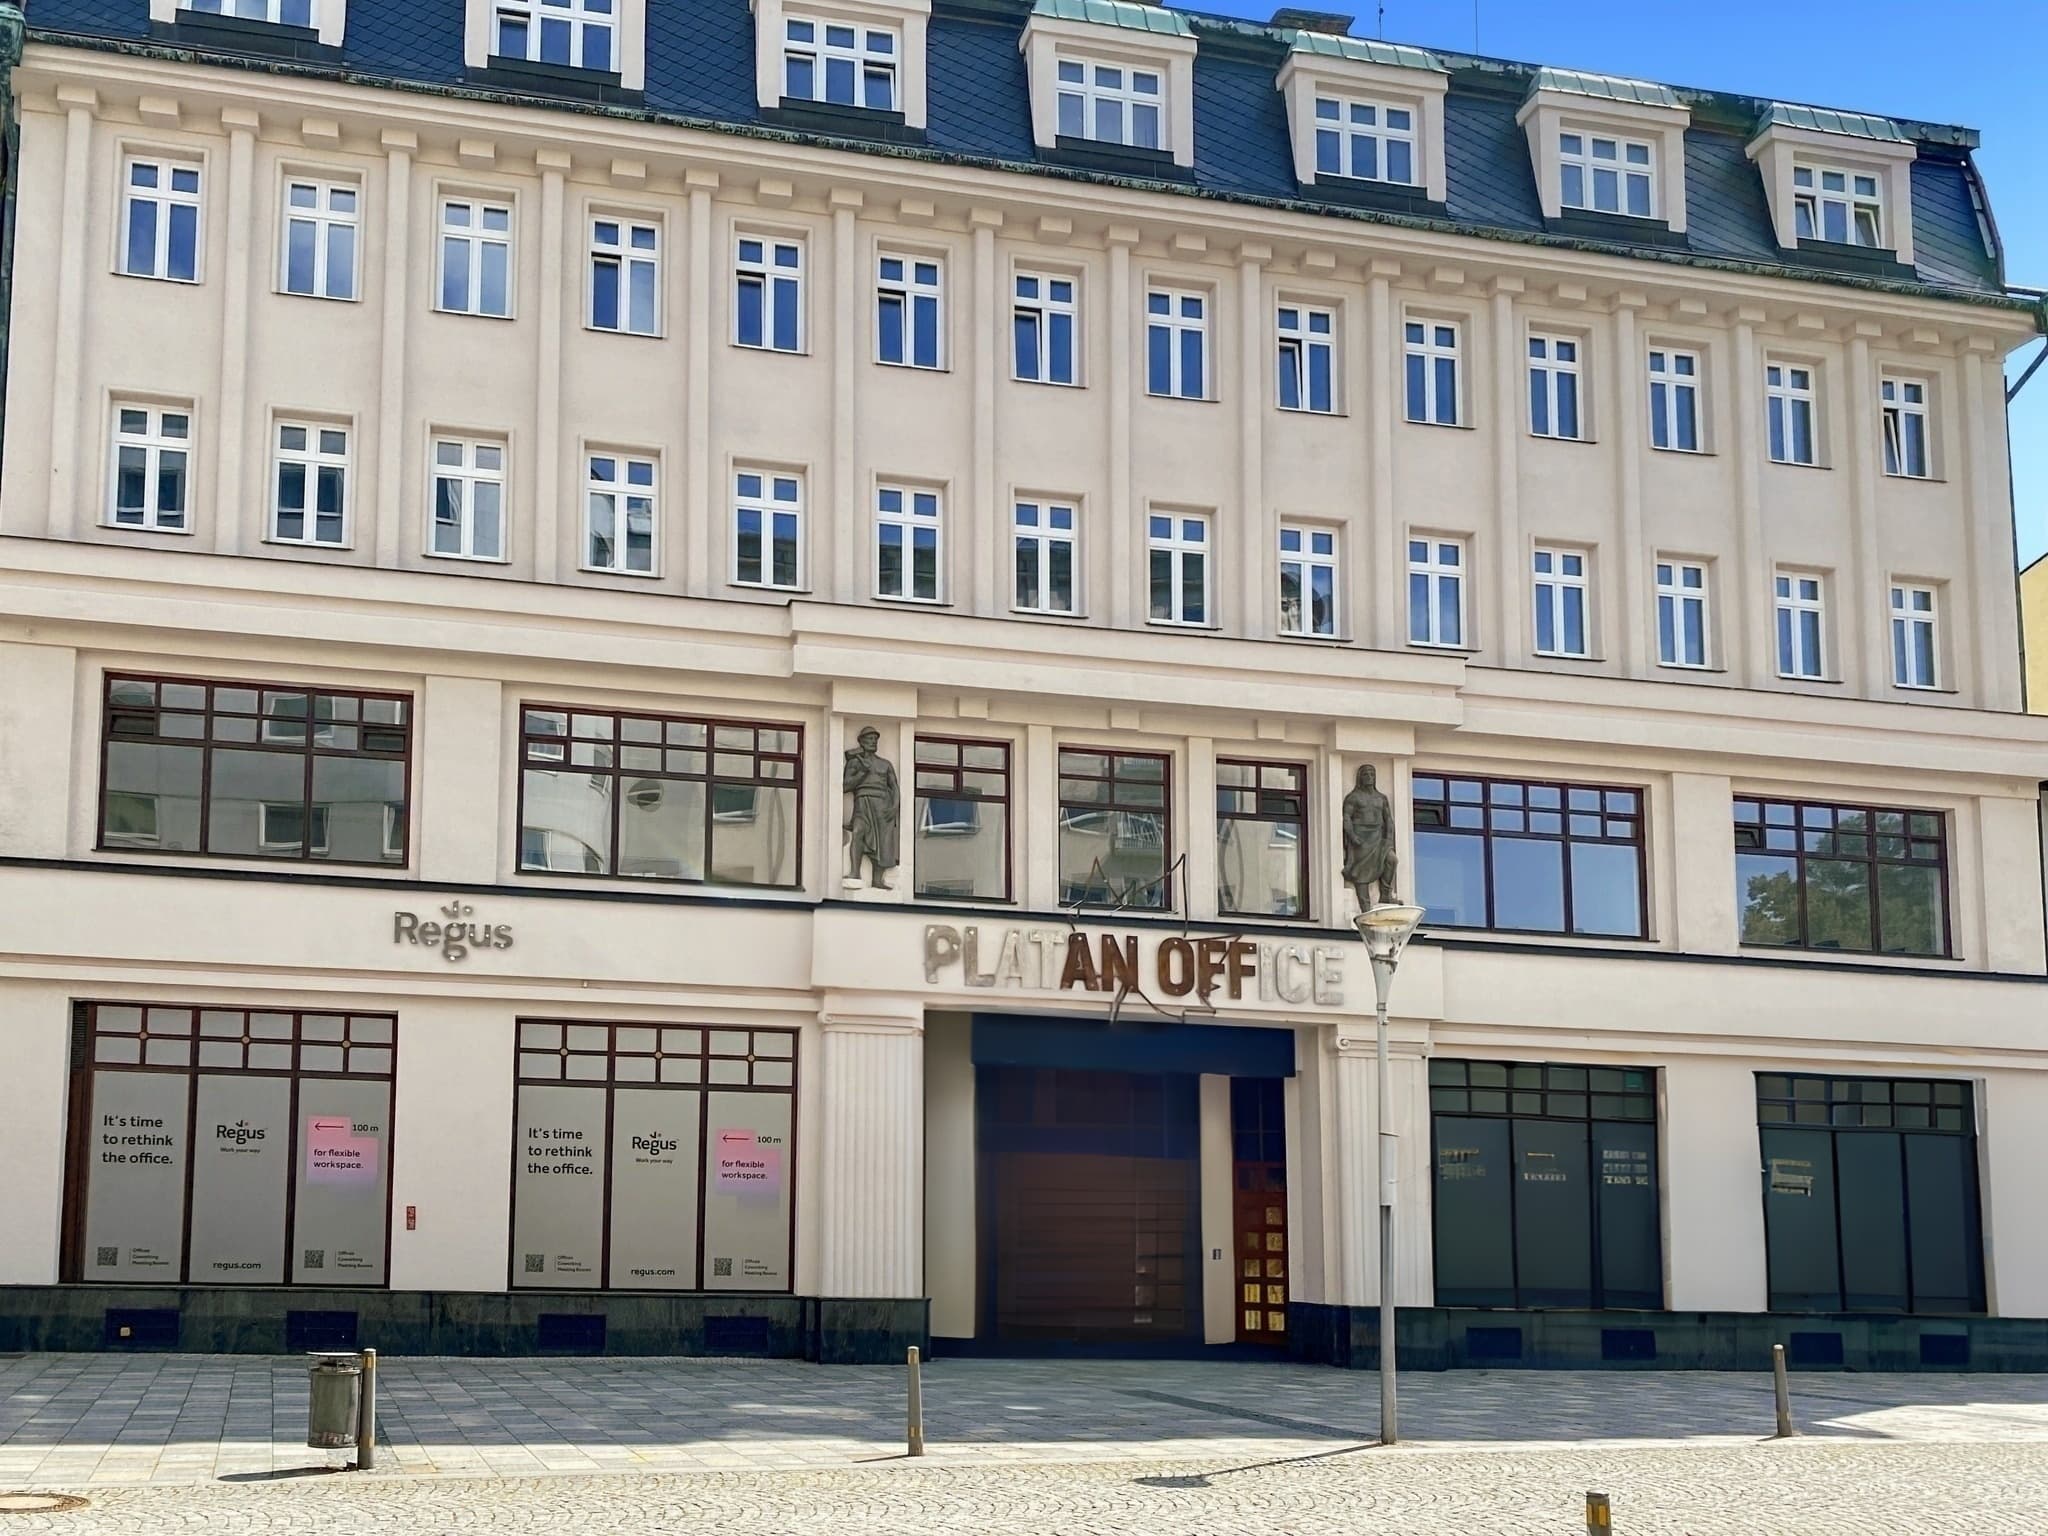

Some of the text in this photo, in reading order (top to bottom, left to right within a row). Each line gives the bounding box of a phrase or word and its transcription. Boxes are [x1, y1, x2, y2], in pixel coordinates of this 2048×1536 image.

[394, 912, 514, 961] Regus
[924, 924, 1345, 1006] PLATAN OFFICE
[103, 1114, 163, 1129] It's time
[352, 1124, 368, 1132] 100
[528, 1127, 583, 1140] It's time
[103, 1133, 173, 1147] to rethink
[216, 1125, 266, 1145] Regus
[757, 1136, 772, 1144] 100
[528, 1145, 592, 1158] to rethink
[632, 1136, 677, 1155] Regus
[102, 1151, 174, 1165] the office.
[313, 1148, 361, 1158] for flexible
[313, 1160, 364, 1171] workspace.
[527, 1163, 593, 1175] the office.
[722, 1160, 765, 1169] for flexible
[721, 1171, 768, 1181] workspace.
[212, 1260, 262, 1271] regus.com
[630, 1267, 675, 1277] regus.com
